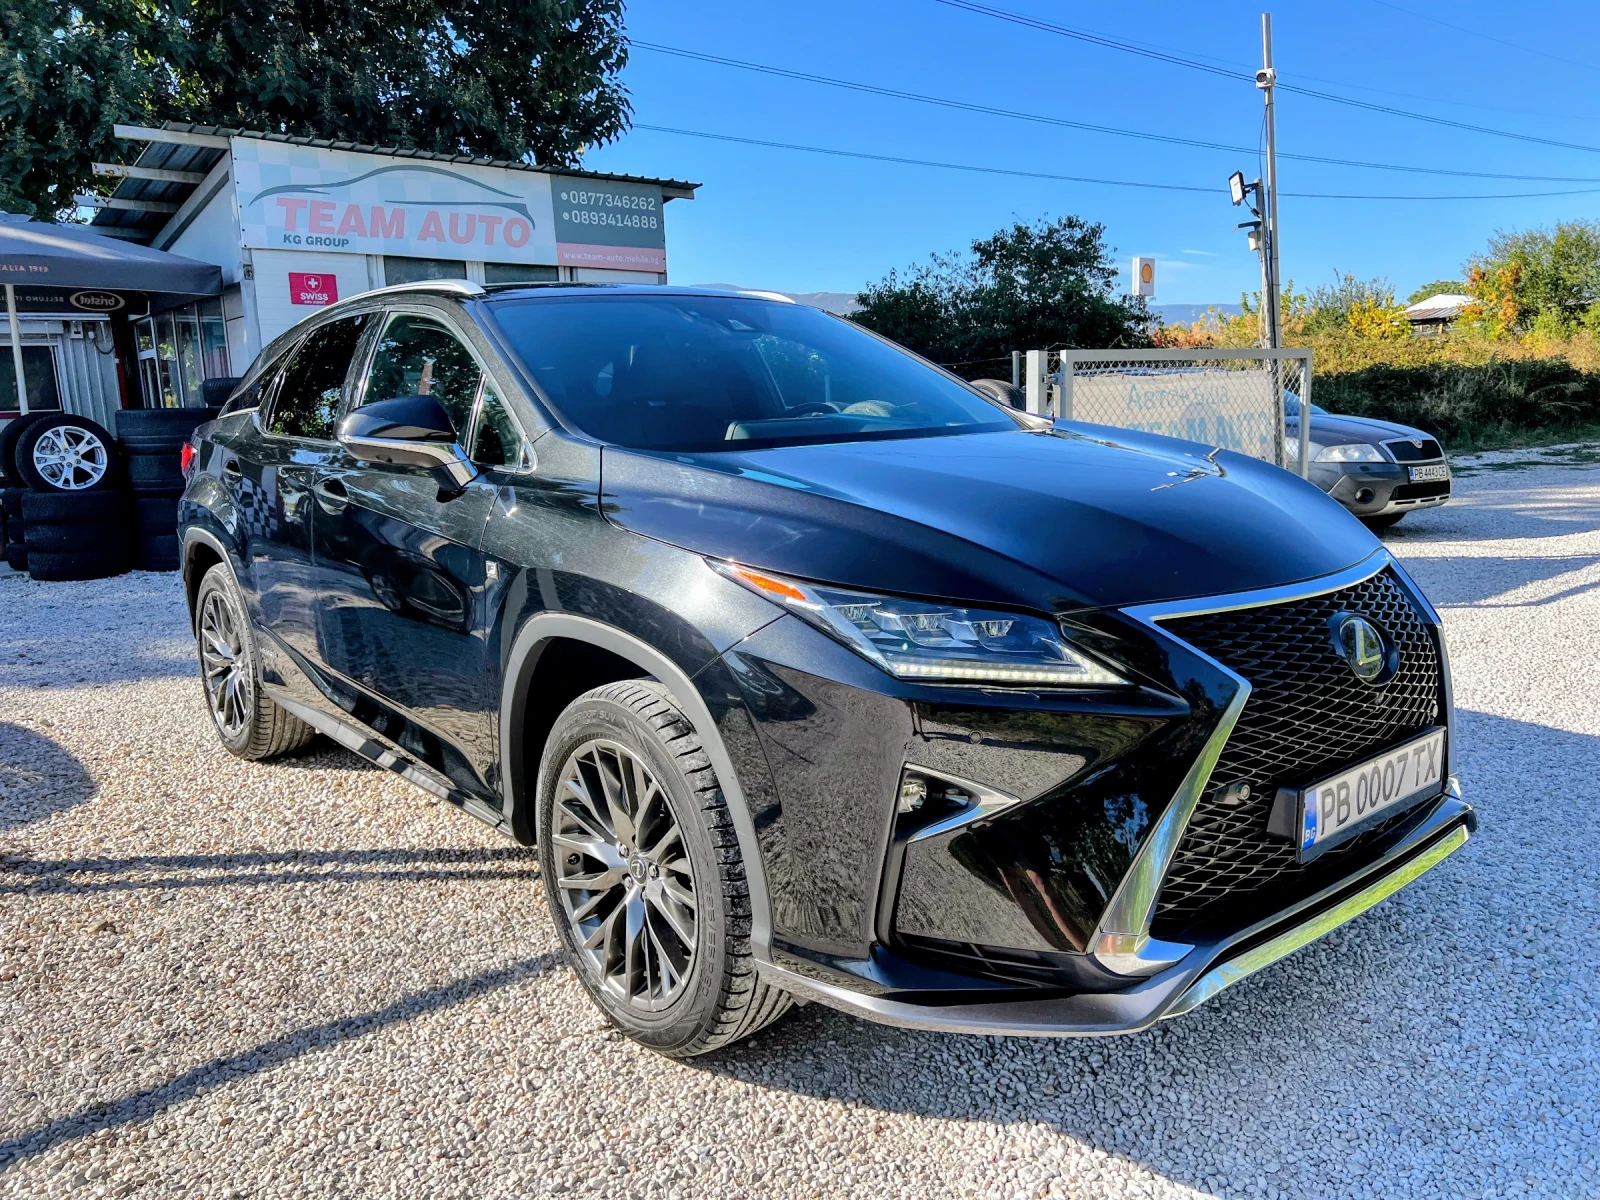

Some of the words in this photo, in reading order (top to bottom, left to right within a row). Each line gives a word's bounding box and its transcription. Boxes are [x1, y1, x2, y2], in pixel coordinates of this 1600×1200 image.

[569, 190, 656, 211] 0877346262
[276, 197, 407, 239] TEAM
[417, 210, 530, 248] AUTO
[571, 210, 658, 229] 0893414888
[283, 234, 302, 245] KG
[305, 236, 350, 248] GROUP
[0, 264, 25, 272] ALIA
[300, 292, 329, 301] SWISS
[1320, 782, 1350, 836] PB
[1356, 753, 1408, 815] 0007
[1413, 738, 1439, 787] TX
[1304, 826, 1316, 843] BG
